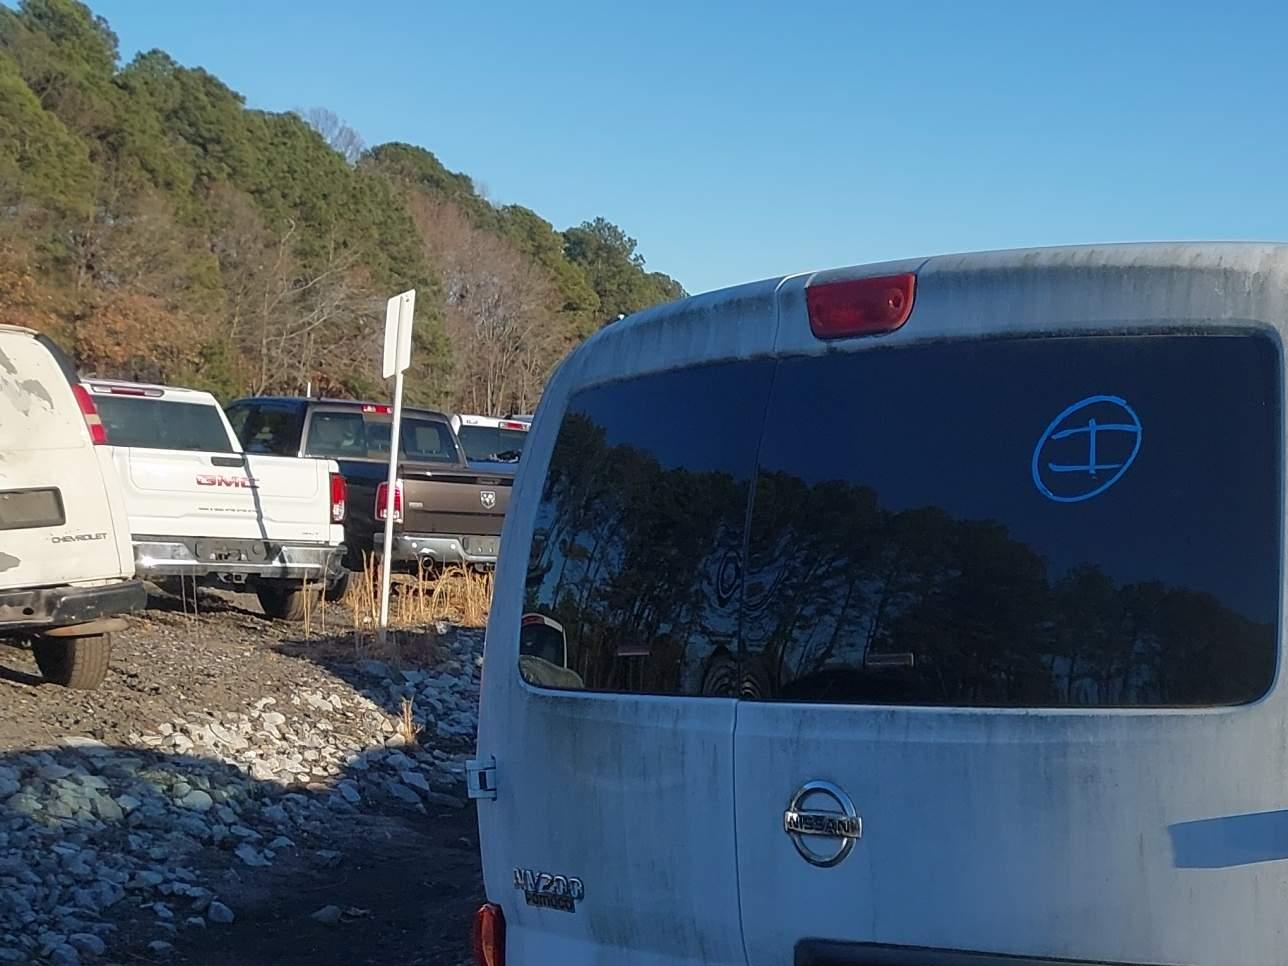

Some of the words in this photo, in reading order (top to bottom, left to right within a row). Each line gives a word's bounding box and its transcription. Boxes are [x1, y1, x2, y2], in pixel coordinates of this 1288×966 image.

[195, 474, 261, 489] GMC
[51, 532, 107, 544] CHEVROLET
[788, 813, 851, 835] NISSAN
[513, 866, 585, 901] NV200
